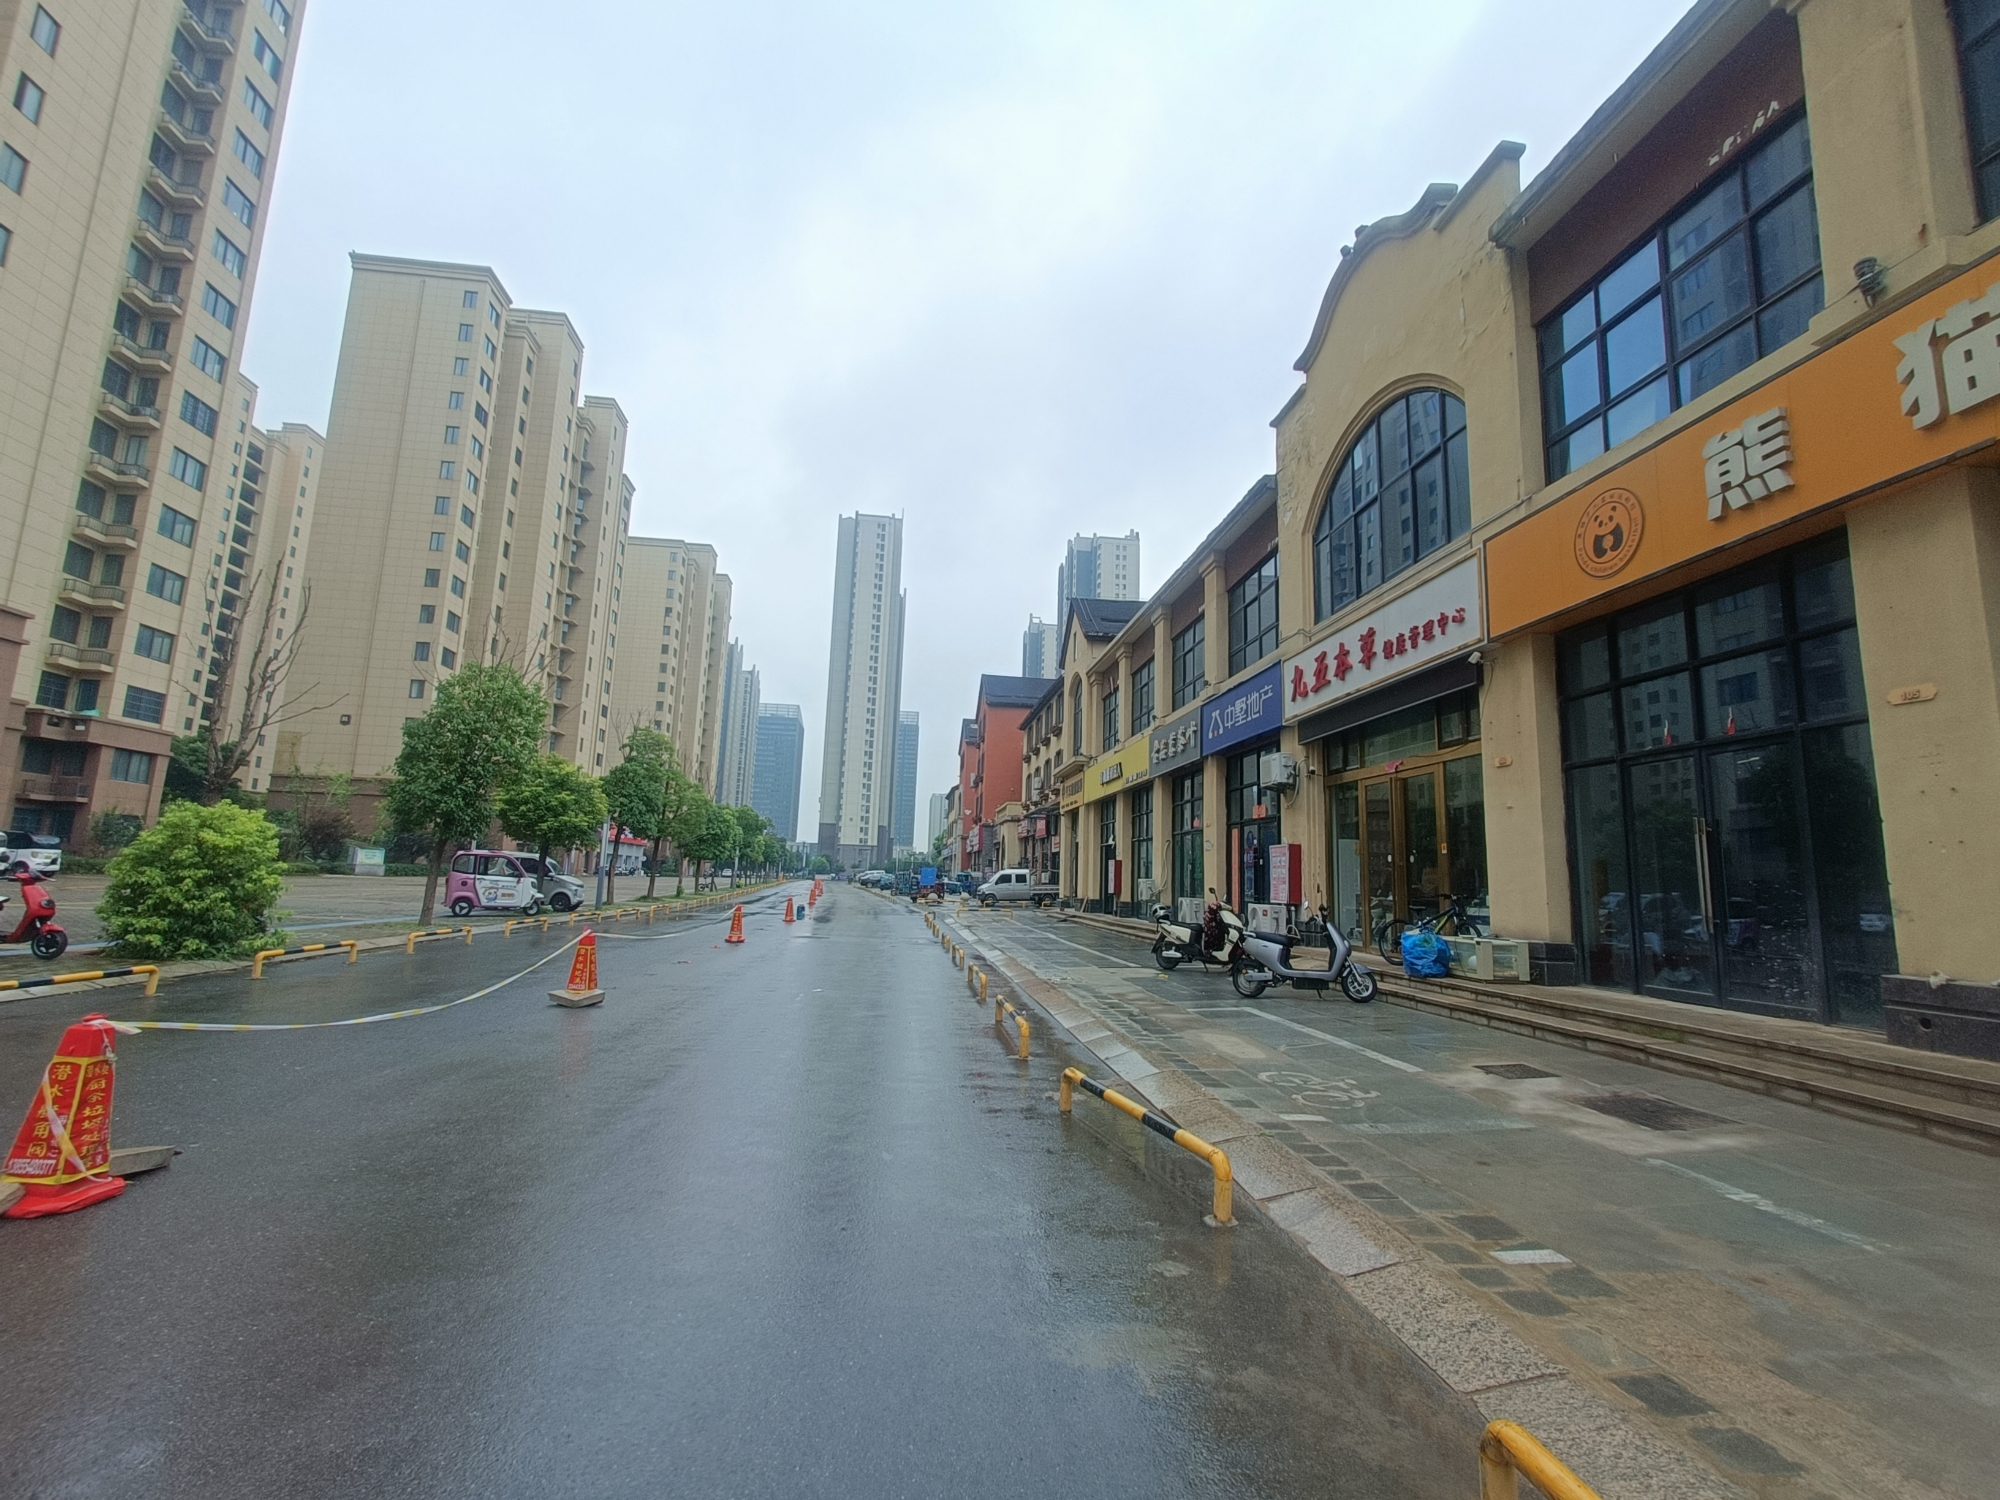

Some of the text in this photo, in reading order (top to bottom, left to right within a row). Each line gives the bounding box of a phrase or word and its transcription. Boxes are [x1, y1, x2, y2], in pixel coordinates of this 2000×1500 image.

[1382, 607, 1466, 660] 健康管理中心
[1290, 626, 1378, 703] 九五本草
[1224, 684, 1273, 729] 中墅地产
